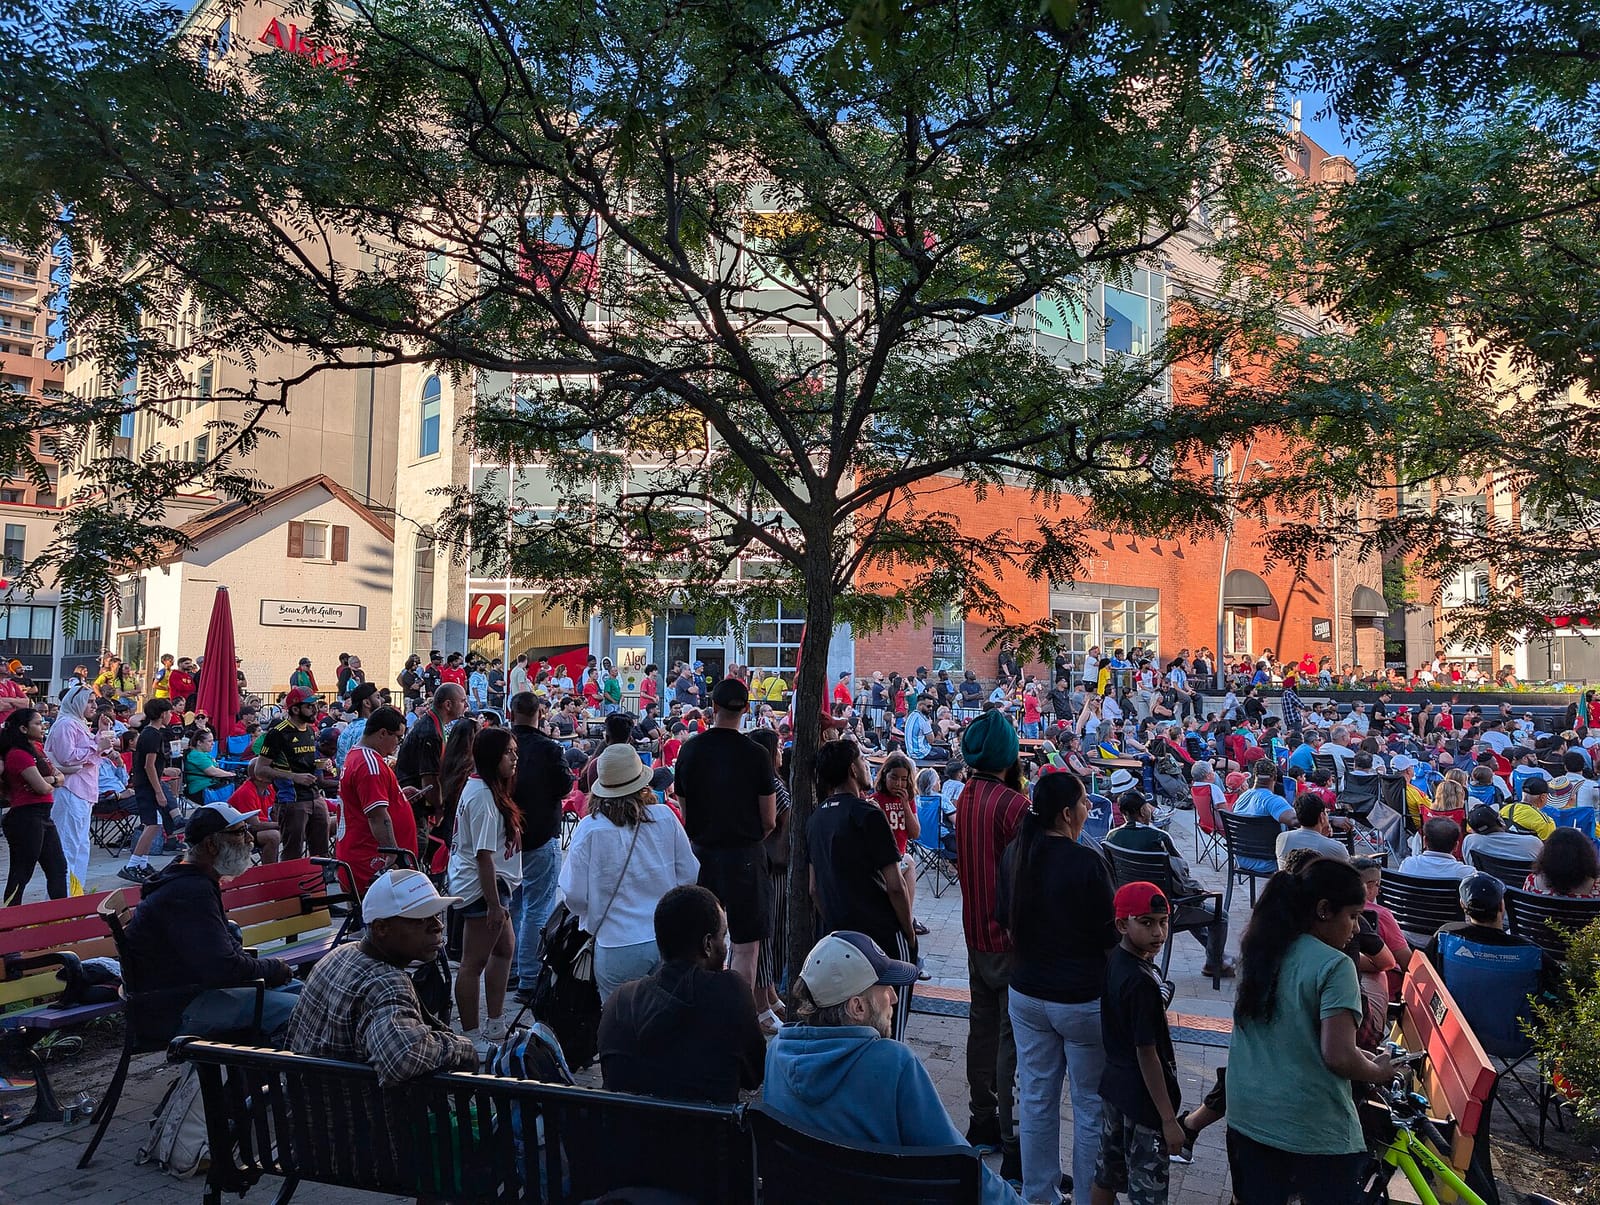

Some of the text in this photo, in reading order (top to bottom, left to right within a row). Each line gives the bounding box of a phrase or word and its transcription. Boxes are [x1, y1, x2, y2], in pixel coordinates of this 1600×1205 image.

[278, 604, 343, 618] Beaux Arts Gallery
[890, 811, 905, 831] 93
